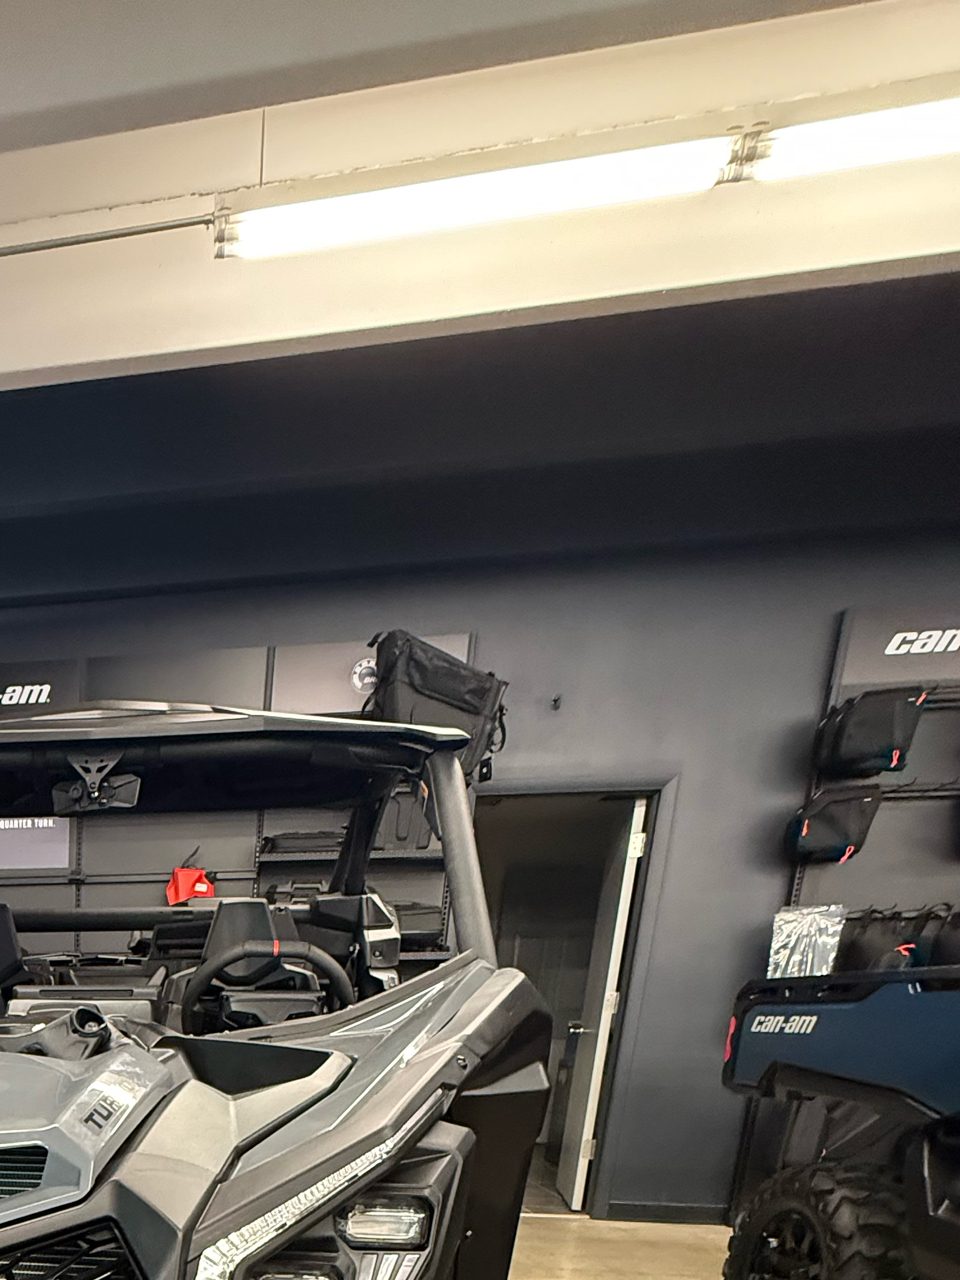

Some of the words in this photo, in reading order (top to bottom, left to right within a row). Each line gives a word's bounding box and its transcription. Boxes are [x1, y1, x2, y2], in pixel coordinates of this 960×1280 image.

[0, 819, 33, 830] QUARTER
[35, 818, 56, 829] TURN.
[750, 1015, 818, 1034] can-am
